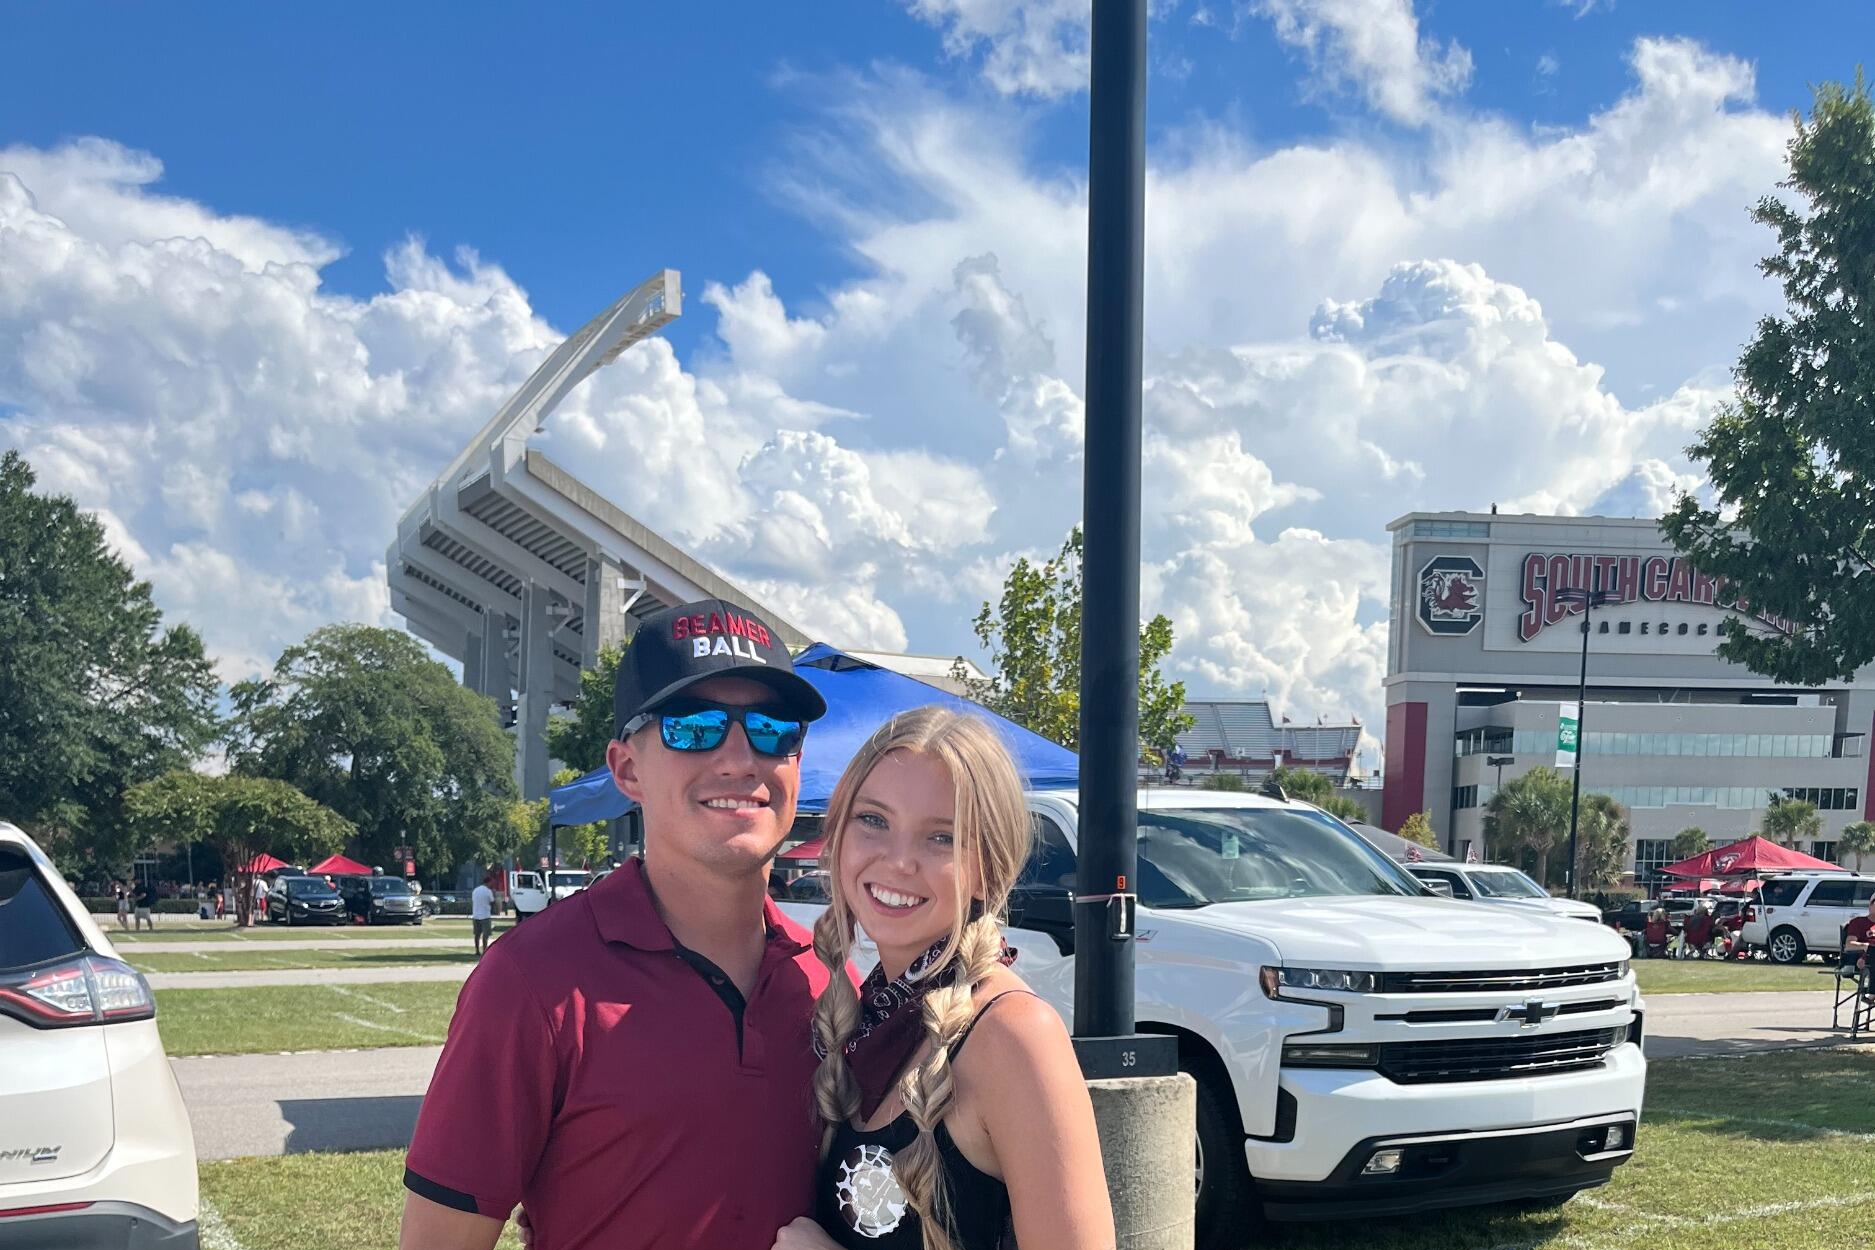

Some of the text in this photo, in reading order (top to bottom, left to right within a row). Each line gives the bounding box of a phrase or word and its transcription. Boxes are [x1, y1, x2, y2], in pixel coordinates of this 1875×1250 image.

[1517, 552, 1640, 643] SOUTH
[672, 611, 771, 648] BEAMER
[693, 635, 767, 664] BALL
[1122, 1051, 1136, 1067] 35
